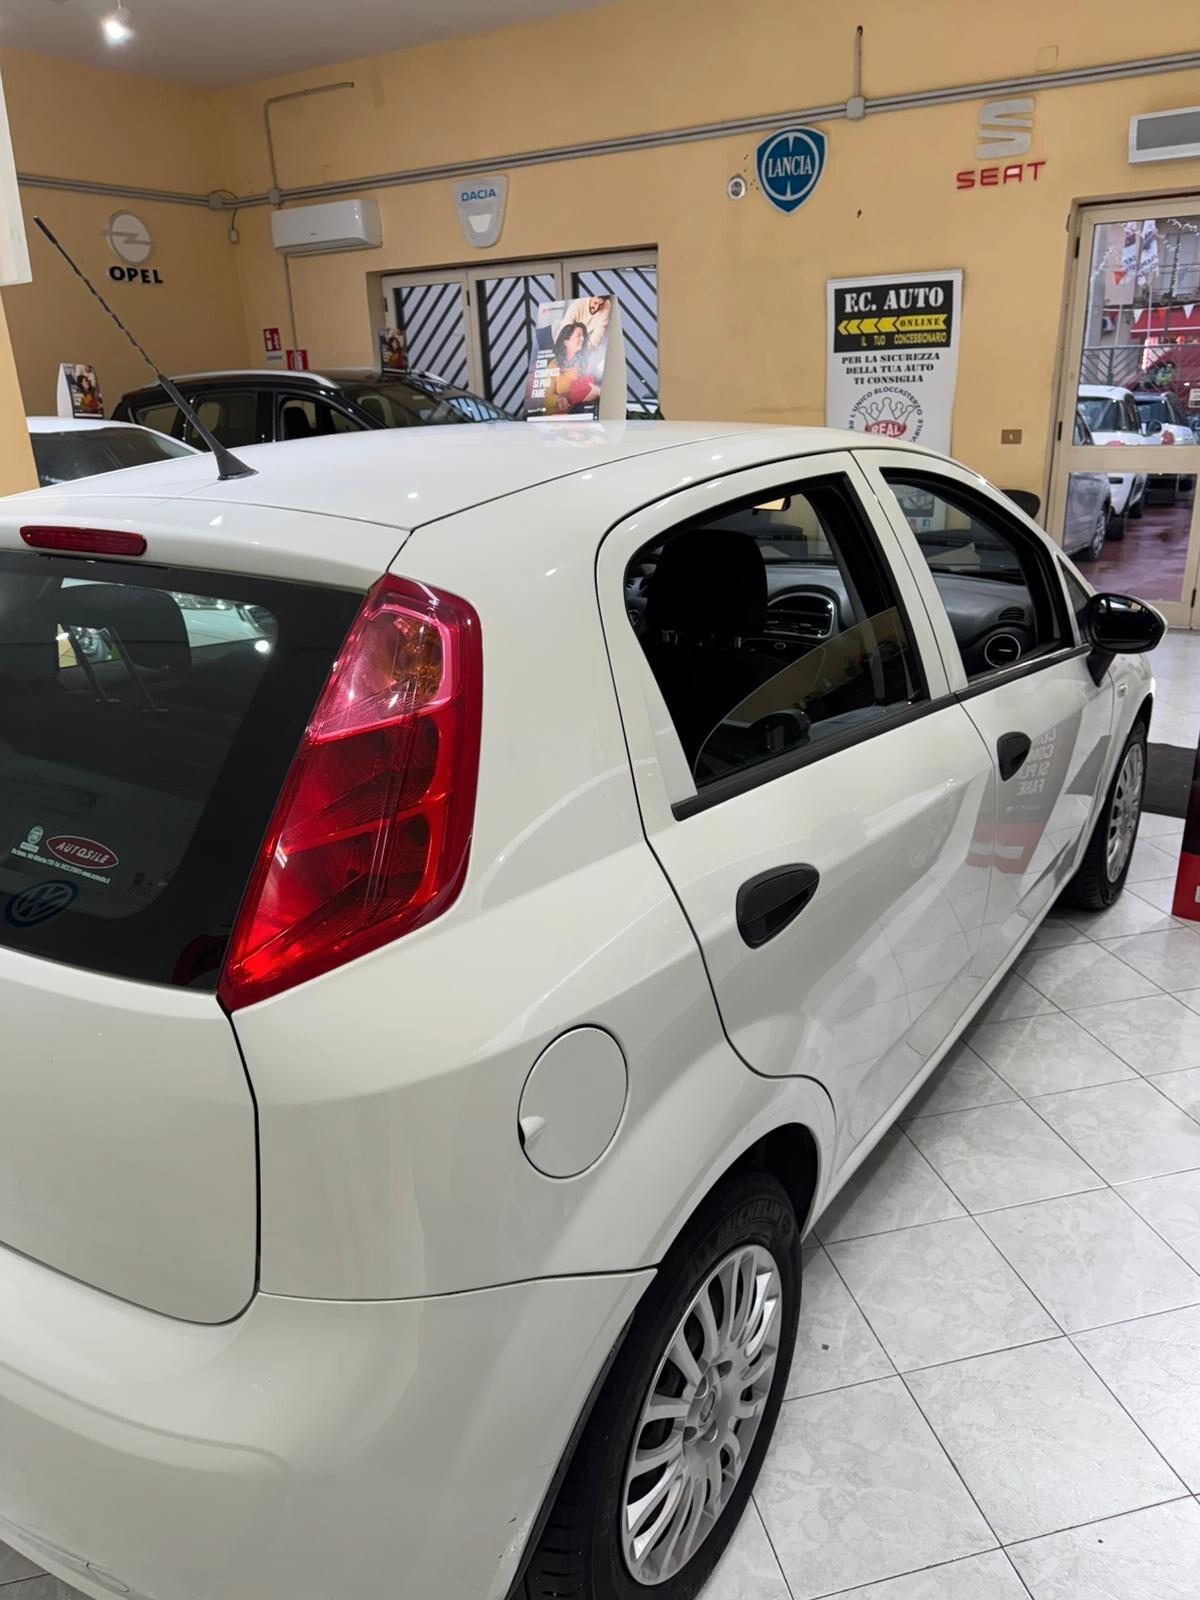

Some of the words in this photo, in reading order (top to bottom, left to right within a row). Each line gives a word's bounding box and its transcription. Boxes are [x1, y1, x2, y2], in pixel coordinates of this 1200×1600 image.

[767, 154, 813, 178] LANCIA
[956, 161, 1046, 190] SEAT
[461, 188, 497, 202] DACIA
[109, 266, 164, 284] OPEL
[844, 291, 877, 313] F.C.
[883, 286, 944, 310] AUTO
[900, 317, 941, 328] ONLINE
[861, 336, 867, 347] IL
[873, 334, 886, 347] TUO
[893, 332, 947, 345] CONCESSIONARIO
[842, 356, 861, 365] PER
[865, 355, 878, 363] LA
[880, 352, 940, 363] SICUREZZA
[846, 366, 878, 375] DELLA
[880, 365, 901, 373] TUA
[905, 363, 934, 372] AUTO
[853, 377, 864, 385] TI
[867, 375, 923, 385] CONSIGLIA
[871, 422, 901, 437] REAL
